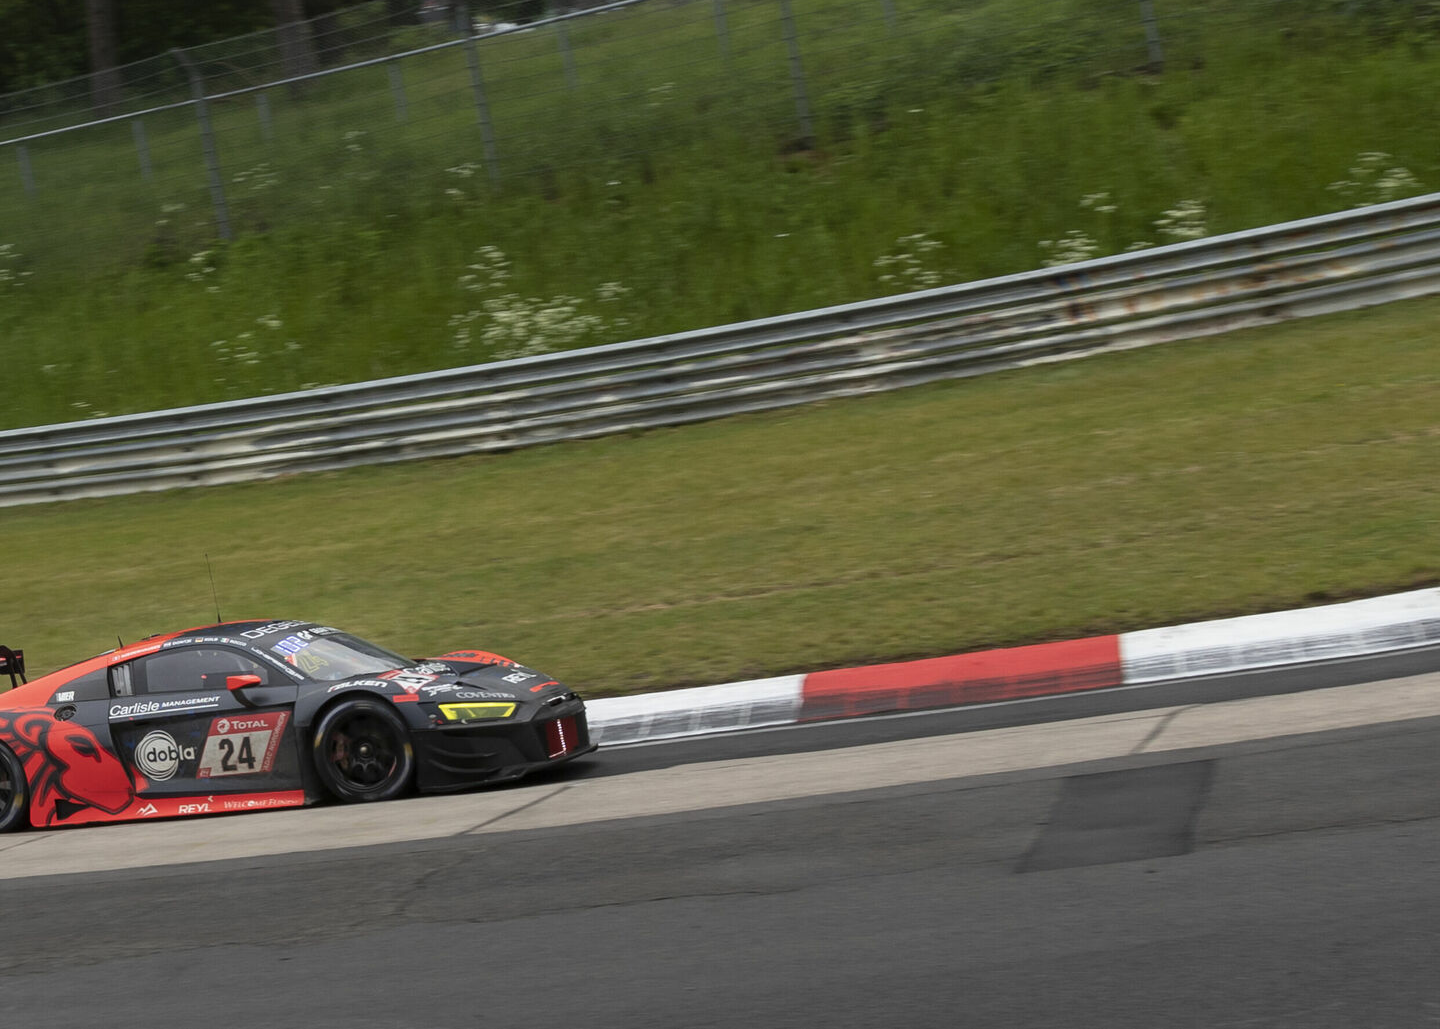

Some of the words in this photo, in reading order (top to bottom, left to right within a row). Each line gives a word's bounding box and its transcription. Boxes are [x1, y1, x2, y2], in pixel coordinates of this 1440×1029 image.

[328, 680, 388, 693] FALKEN
[109, 701, 160, 716] Carlisle
[161, 696, 220, 708] MANAGEMENT
[146, 745, 196, 763] dobla
[218, 736, 257, 772] 24
[177, 803, 213, 814] REYL
